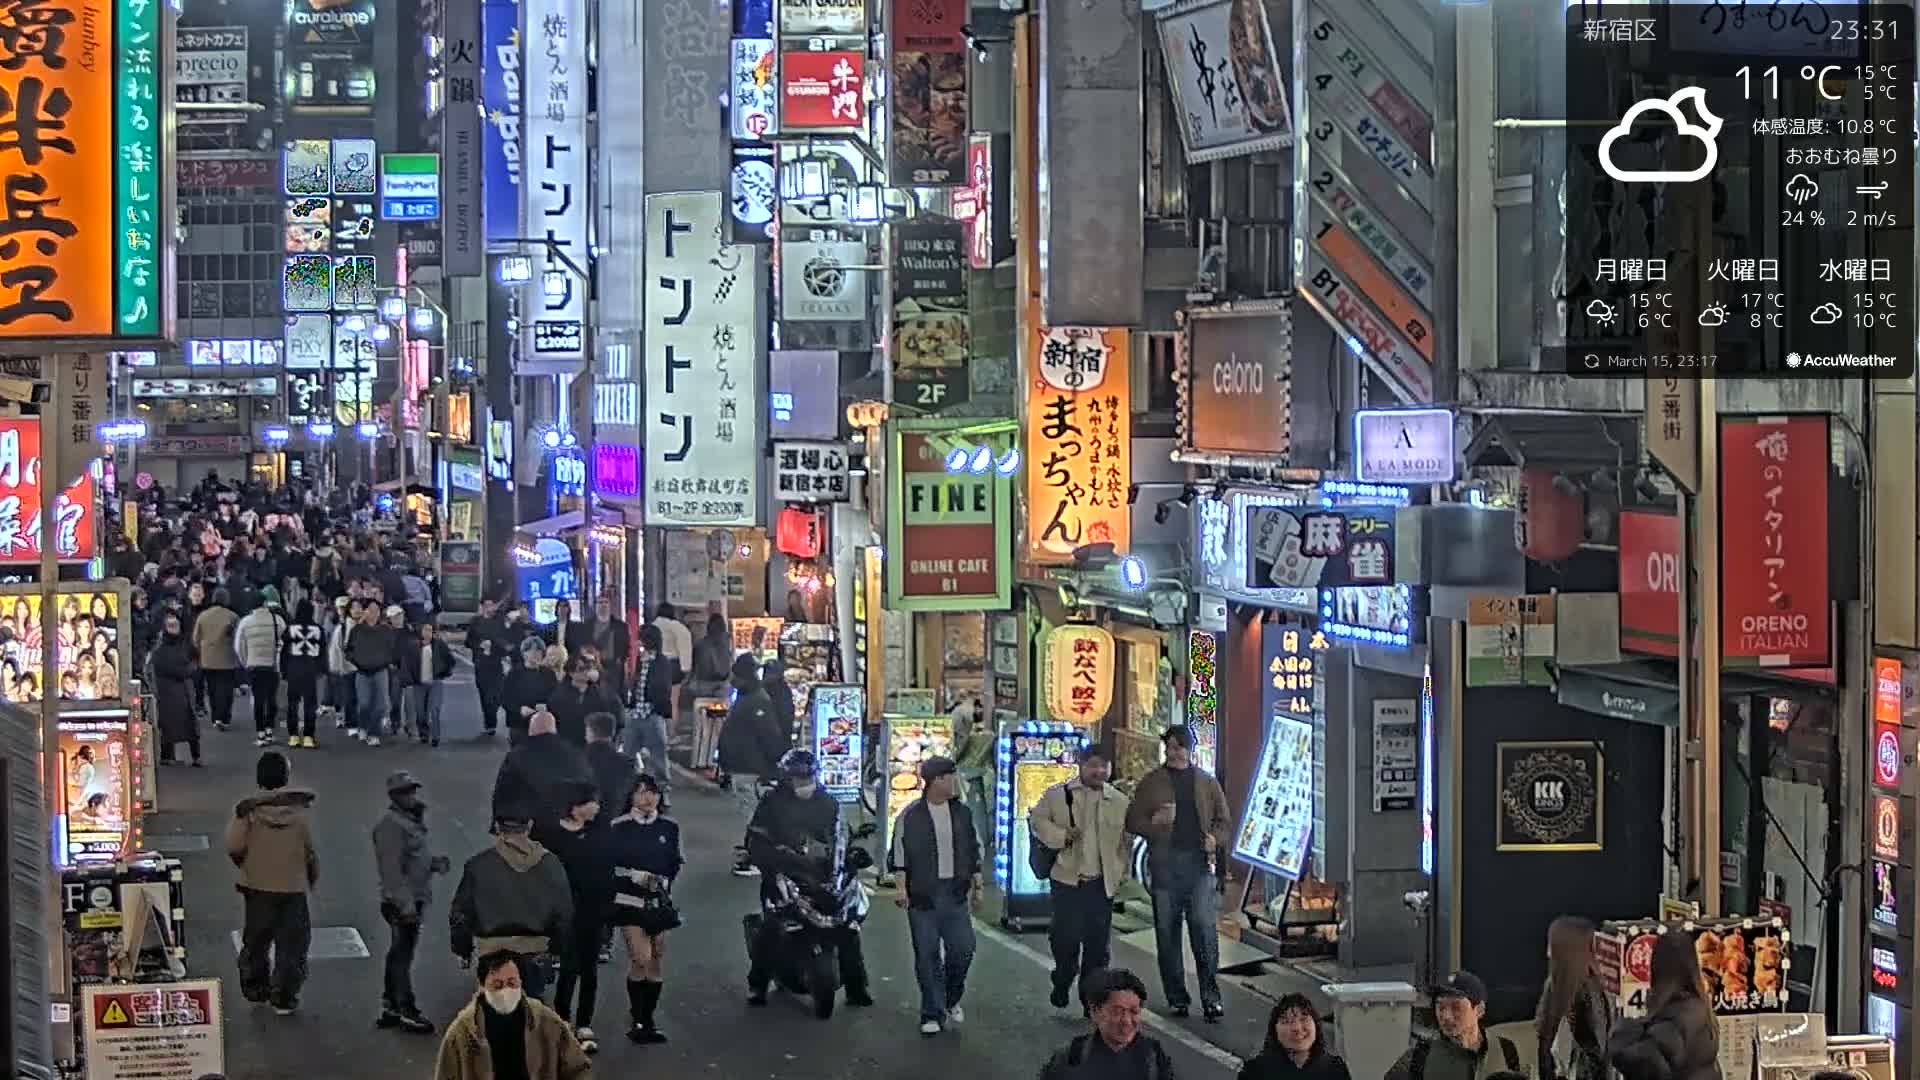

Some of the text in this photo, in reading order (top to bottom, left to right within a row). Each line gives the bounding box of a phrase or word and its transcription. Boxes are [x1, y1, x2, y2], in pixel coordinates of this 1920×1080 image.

[79, 6, 100, 73] hanbey
[1313, 21, 1334, 41] 5
[809, 38, 837, 51] 2F
[451, 39, 474, 101] 火鍋
[543, 14, 568, 122] 焼とん酒場
[831, 57, 859, 120] 牛門
[1314, 73, 1333, 91] 4
[1314, 121, 1334, 141] 3
[385, 180, 437, 192] FamilyMart
[1313, 171, 1334, 193] 2
[541, 135, 573, 312] トントン
[1316, 222, 1333, 239] 1
[901, 254, 960, 269] Walton's
[1312, 268, 1340, 296] B1
[660, 208, 692, 462] トントン
[1043, 339, 1103, 374] 新宿
[712, 324, 737, 442] 焼とん酒場
[1063, 372, 1085, 387] の
[1213, 352, 1263, 394] celona
[72, 352, 92, 443] 通り一番街
[917, 384, 947, 404] 2F
[1394, 422, 1415, 449] A
[779, 449, 843, 470] 酒場心
[1041, 395, 1086, 544] まっちゃん
[779, 474, 843, 492] 新宿本店
[911, 484, 987, 513] FINE
[1349, 518, 1392, 534] フリー
[1755, 430, 1789, 604] 俺のイタリアン
[911, 559, 989, 573] ONLINE CAFE
[1741, 615, 1808, 633] ORENO
[1740, 634, 1808, 650] ITALIAN
[1535, 781, 1564, 799] KK
